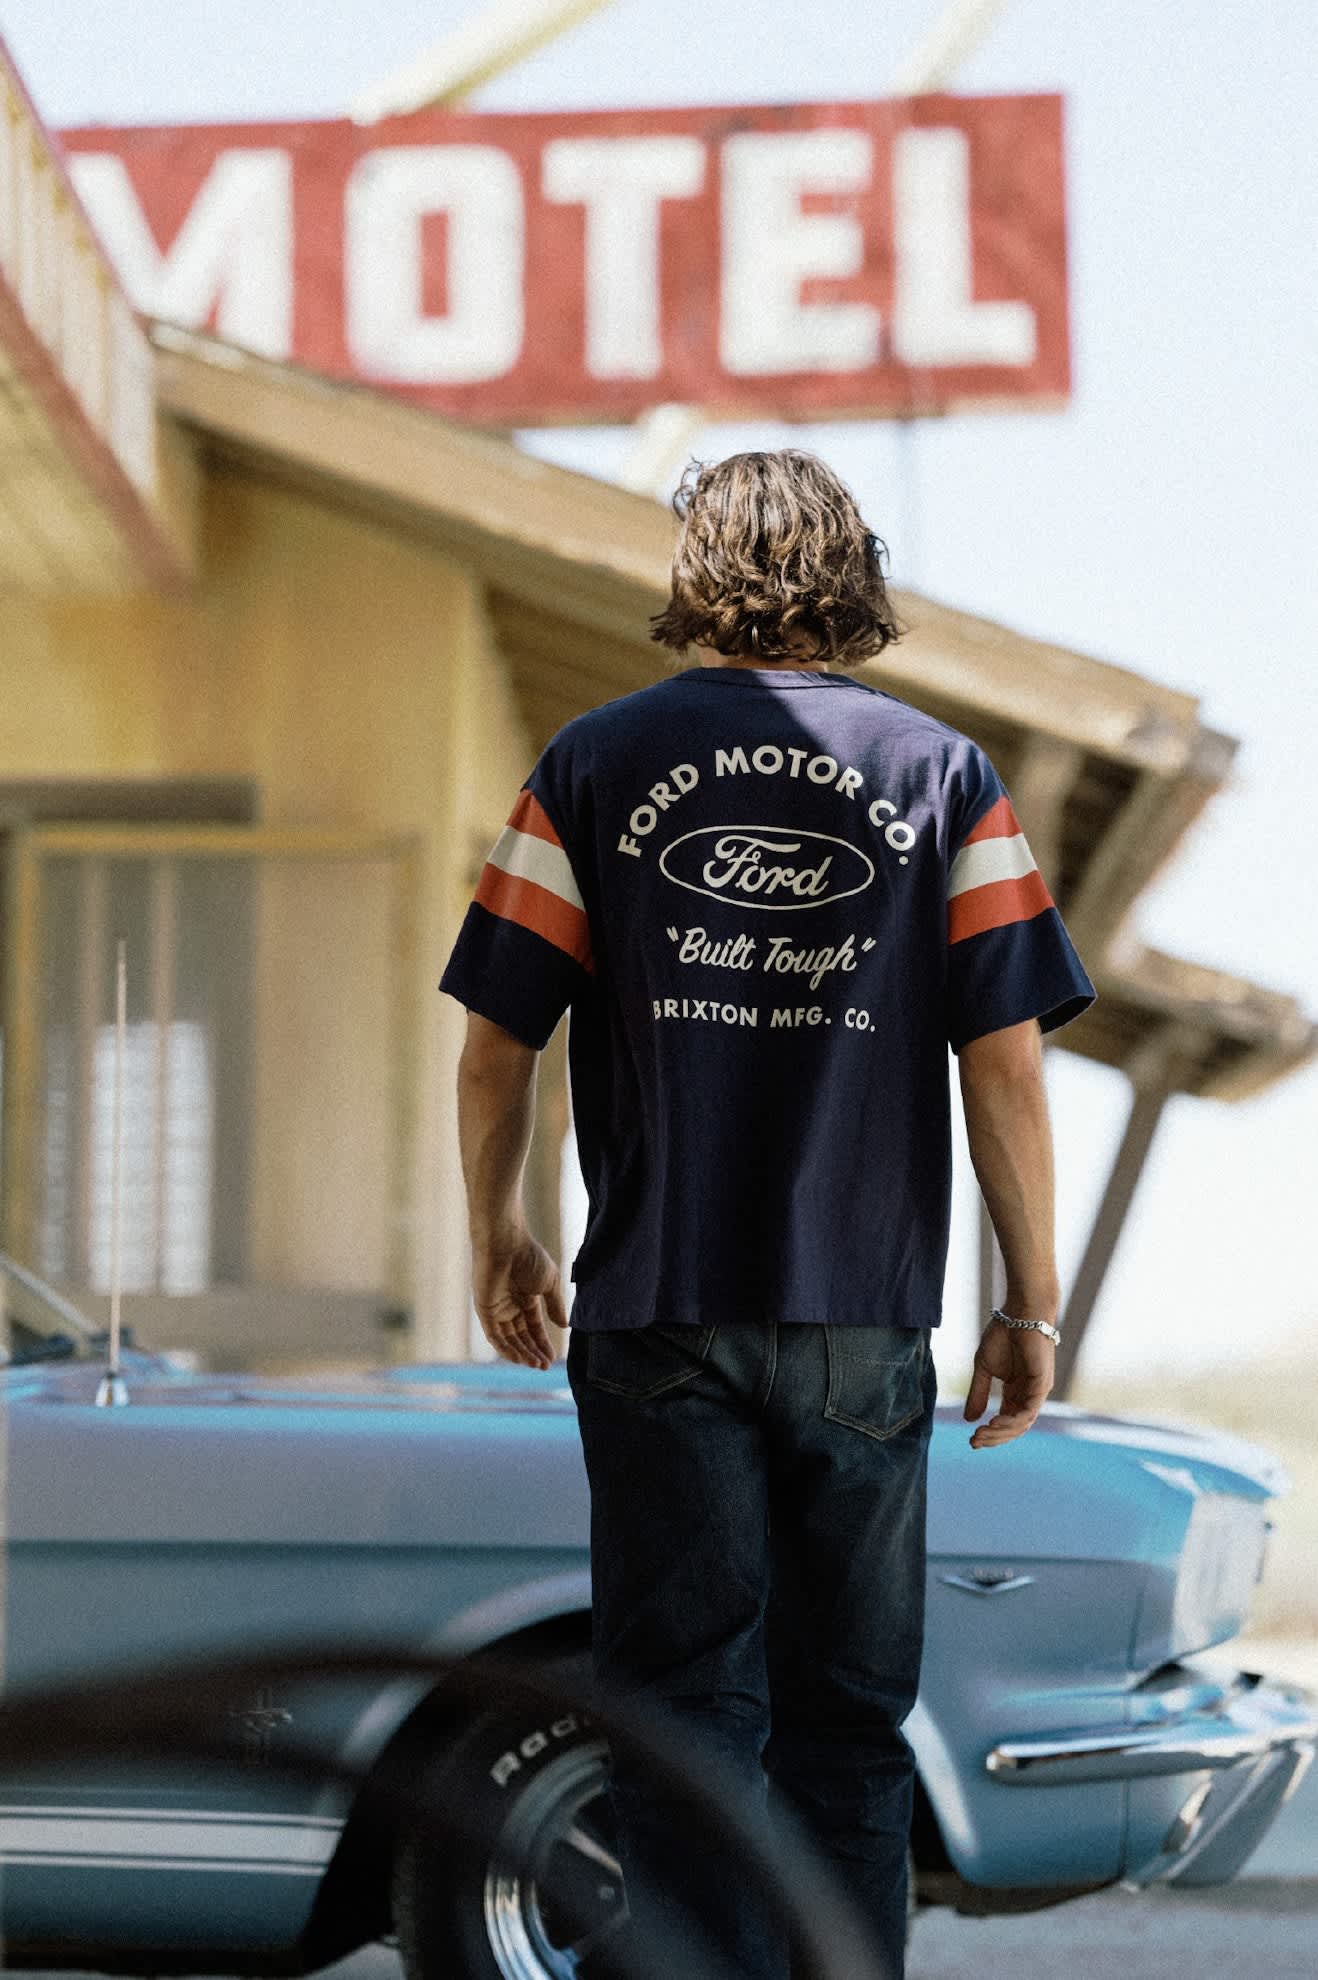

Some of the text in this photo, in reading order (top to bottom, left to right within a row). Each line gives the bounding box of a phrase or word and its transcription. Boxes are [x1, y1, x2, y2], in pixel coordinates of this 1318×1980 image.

[67, 127, 1037, 383] MOTEL
[617, 745, 917, 866] FORD MOTOR CO.
[703, 834, 834, 897] Ford
[652, 998, 877, 1033] BRIXTON MFG. CO.
